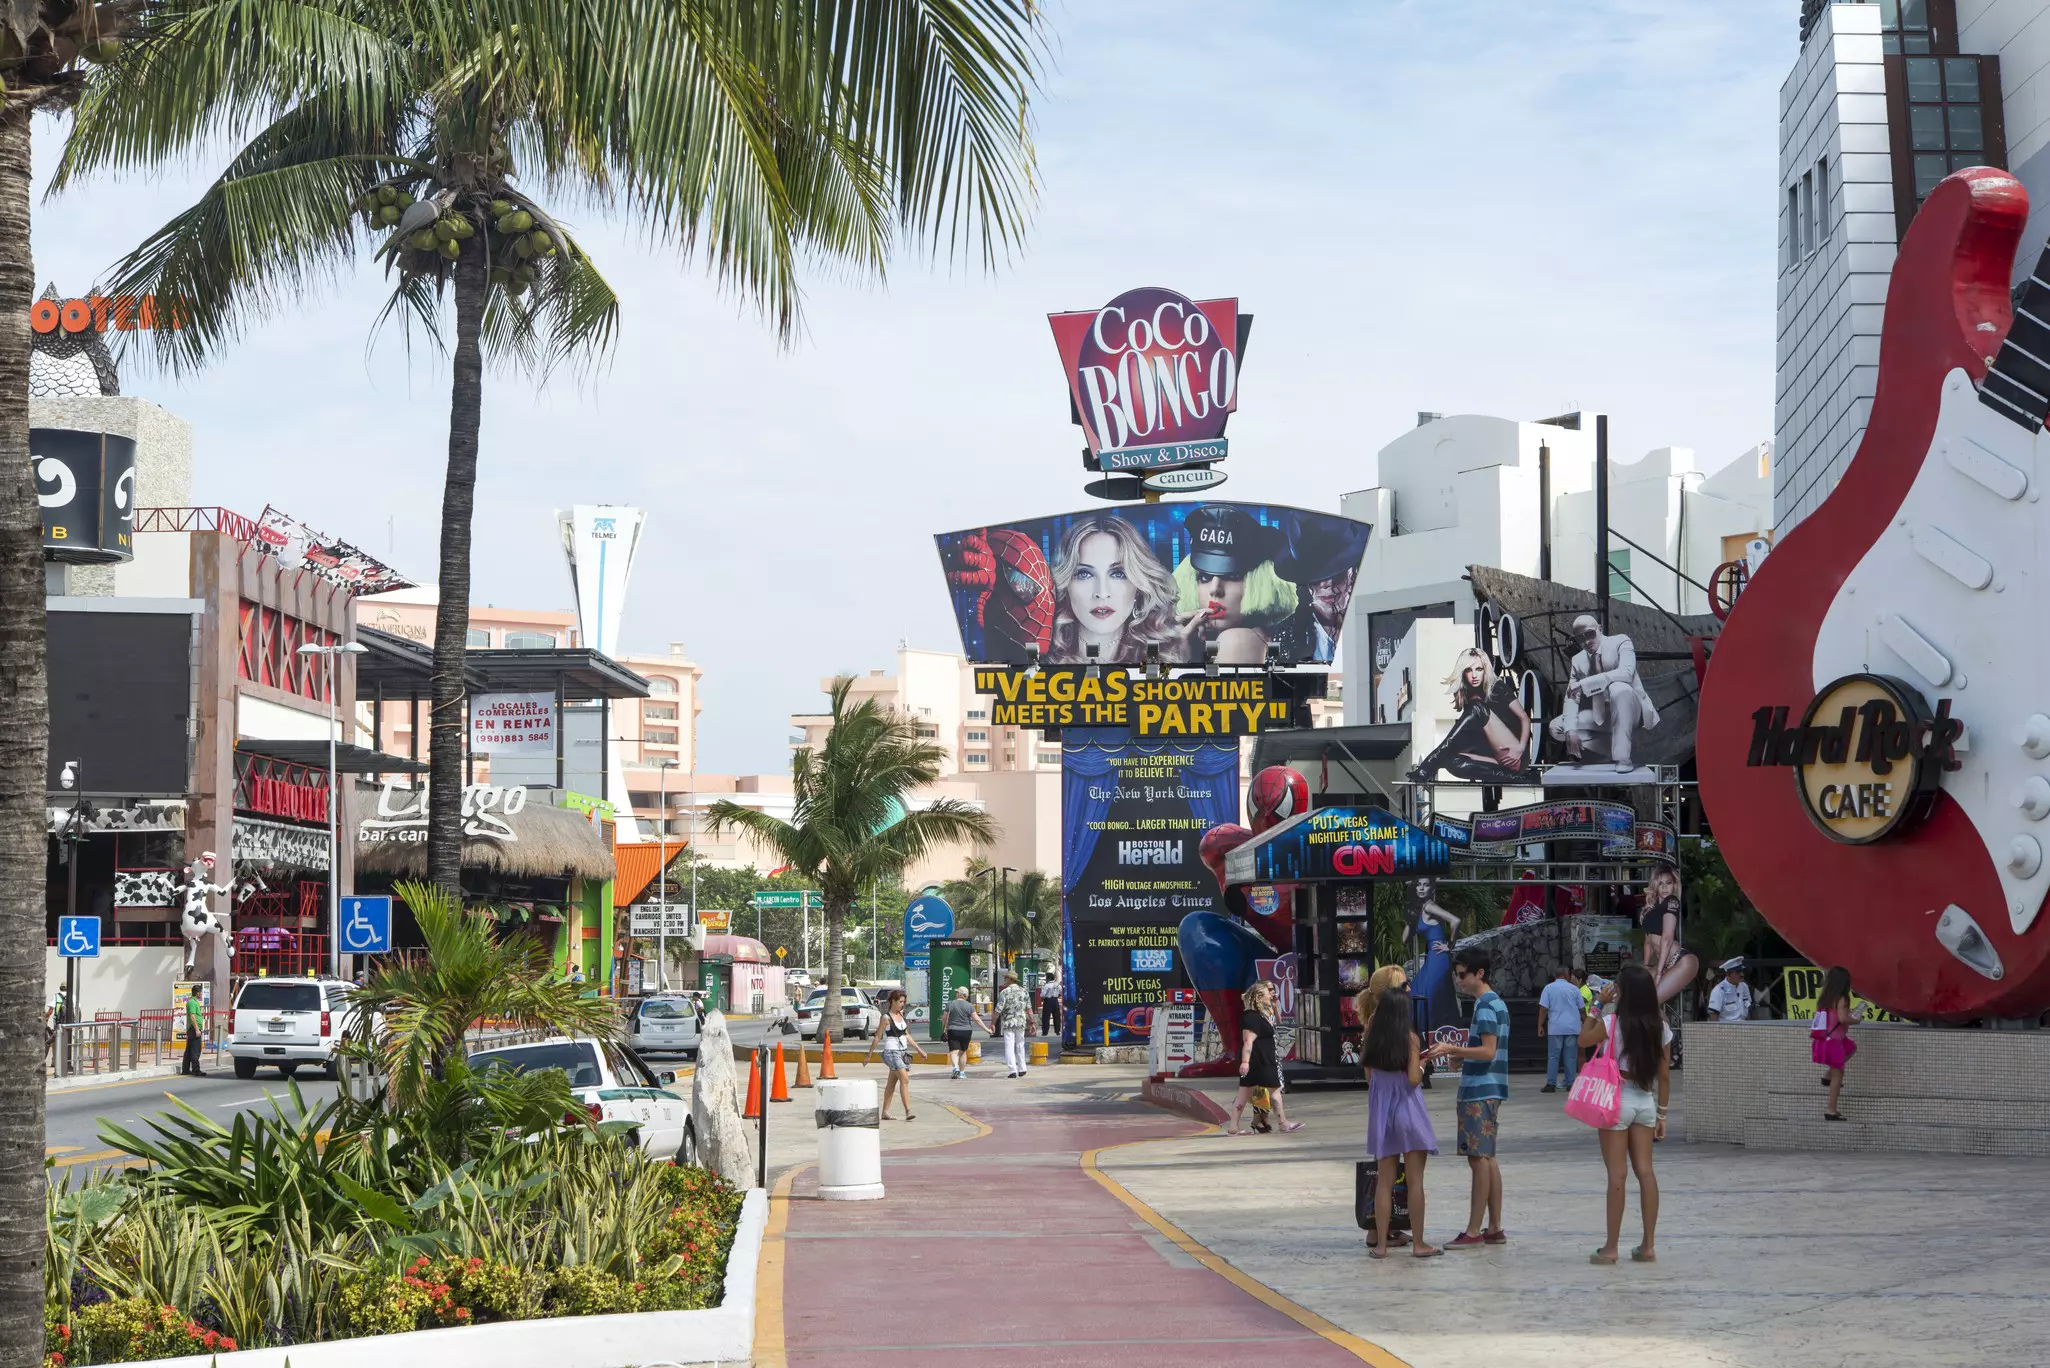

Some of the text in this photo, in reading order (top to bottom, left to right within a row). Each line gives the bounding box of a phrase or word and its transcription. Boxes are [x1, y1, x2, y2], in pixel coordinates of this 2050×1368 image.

[1094, 302, 1209, 354] CoCo
[1079, 347, 1236, 452] BONGO
[1112, 452, 1152, 468] Show
[1158, 448, 1171, 463] &
[1160, 470, 1213, 484] cancun
[1200, 528, 1233, 544] GAGA
[977, 672, 1264, 702] "VEGAS SHOWTIME
[478, 708, 548, 716] COMERCIALES
[995, 702, 1286, 734] MEETS THE PARTY"
[475, 718, 550, 729] EN RENTA
[528, 733, 548, 741] 5845
[1747, 699, 1964, 775] Hard Rock
[1124, 758, 1138, 766] HAVE
[1140, 757, 1148, 766] TO
[1150, 755, 1194, 766] EXPERIENCE
[1118, 770, 1124, 778] IT
[1125, 770, 1133, 778] TO
[1134, 768, 1164, 778] BELIEVE
[1089, 785, 1212, 803] The New York Times
[1820, 783, 1892, 819] CAFE
[1136, 820, 1166, 830] LARGER
[1168, 819, 1188, 830] THAN
[1191, 818, 1206, 829] LIFE
[1342, 816, 1368, 828] VEGAS
[1482, 819, 1517, 829] CHICAGO
[1309, 830, 1349, 844] NIGHTLIFE
[1352, 830, 1362, 841] TO
[1364, 827, 1398, 840] SHAME
[1132, 840, 1164, 848] BOSTON
[1119, 840, 1182, 865] Herald
[1333, 845, 1394, 875] CNN
[1126, 882, 1151, 890] VOLTAGE
[1089, 894, 1213, 910] Los Angeles Times
[1098, 939, 1125, 947] PATRICK'S
[1126, 938, 1136, 947] DAY
[1138, 936, 1168, 947] ROLLED
[1146, 950, 1167, 959] USA
[1135, 958, 1168, 968] TODAY
[1136, 979, 1161, 990] VEGAS
[1788, 970, 1824, 1000] OP
[1104, 992, 1142, 1004] NIGHTLIFE
[1144, 992, 1155, 1002] TO
[1584, 1077, 1616, 1111] PINK
